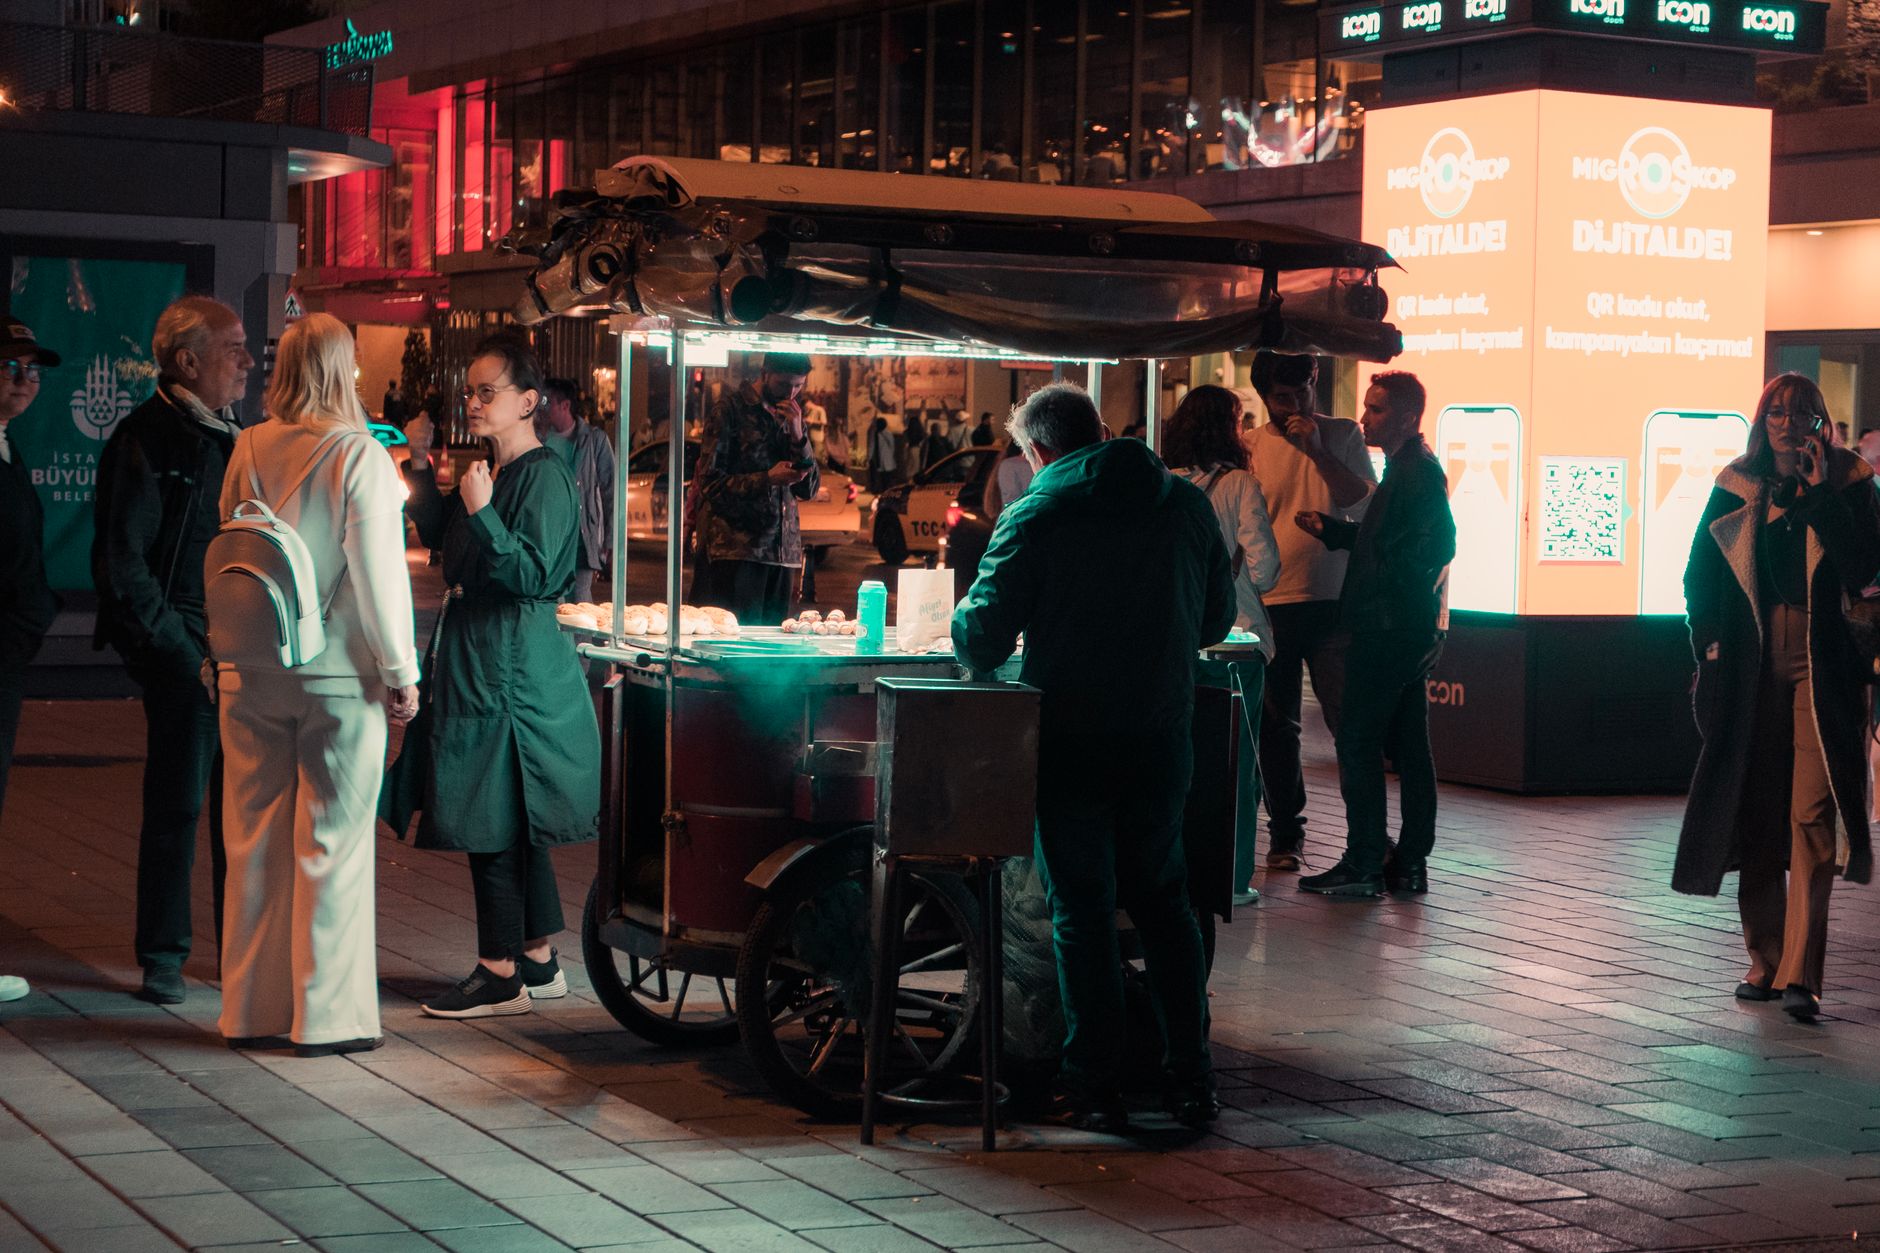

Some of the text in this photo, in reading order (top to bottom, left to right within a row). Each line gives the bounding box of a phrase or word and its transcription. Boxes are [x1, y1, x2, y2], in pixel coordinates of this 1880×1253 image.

[1402, 2, 1442, 29] icon
[1465, 0, 1506, 19] icon
[1571, 0, 1625, 17] icon
[1657, 0, 1711, 26] icon
[1742, 7, 1795, 33] icon
[1342, 12, 1381, 38] icon
[1587, 291, 1711, 322] QR kodu okut,
[53, 451, 96, 464] İSTA
[53, 491, 97, 502] BELE
[1426, 680, 1465, 706] con
